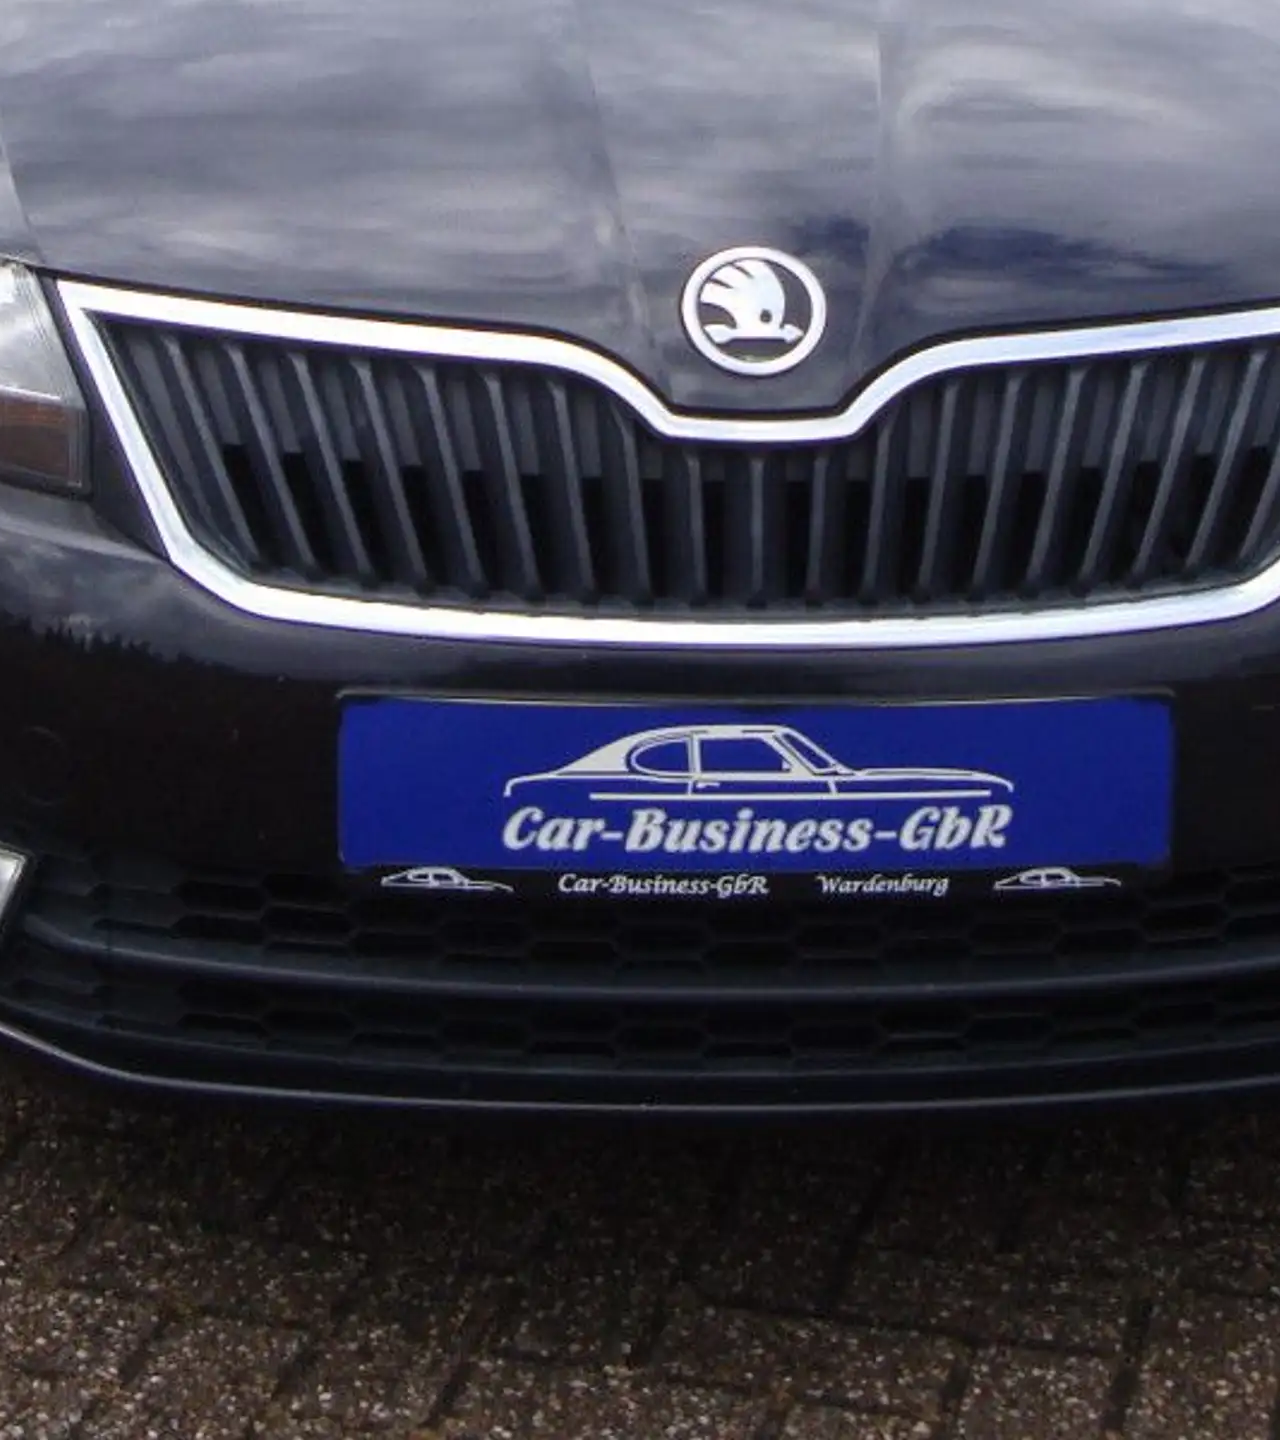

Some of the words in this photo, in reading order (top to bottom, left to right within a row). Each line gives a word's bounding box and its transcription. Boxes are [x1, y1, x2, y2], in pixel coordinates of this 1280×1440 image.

[504, 805, 1009, 852] Car-Business-GbR
[558, 873, 769, 896] Car-Business-GbR
[816, 874, 950, 897] Wardenburg
